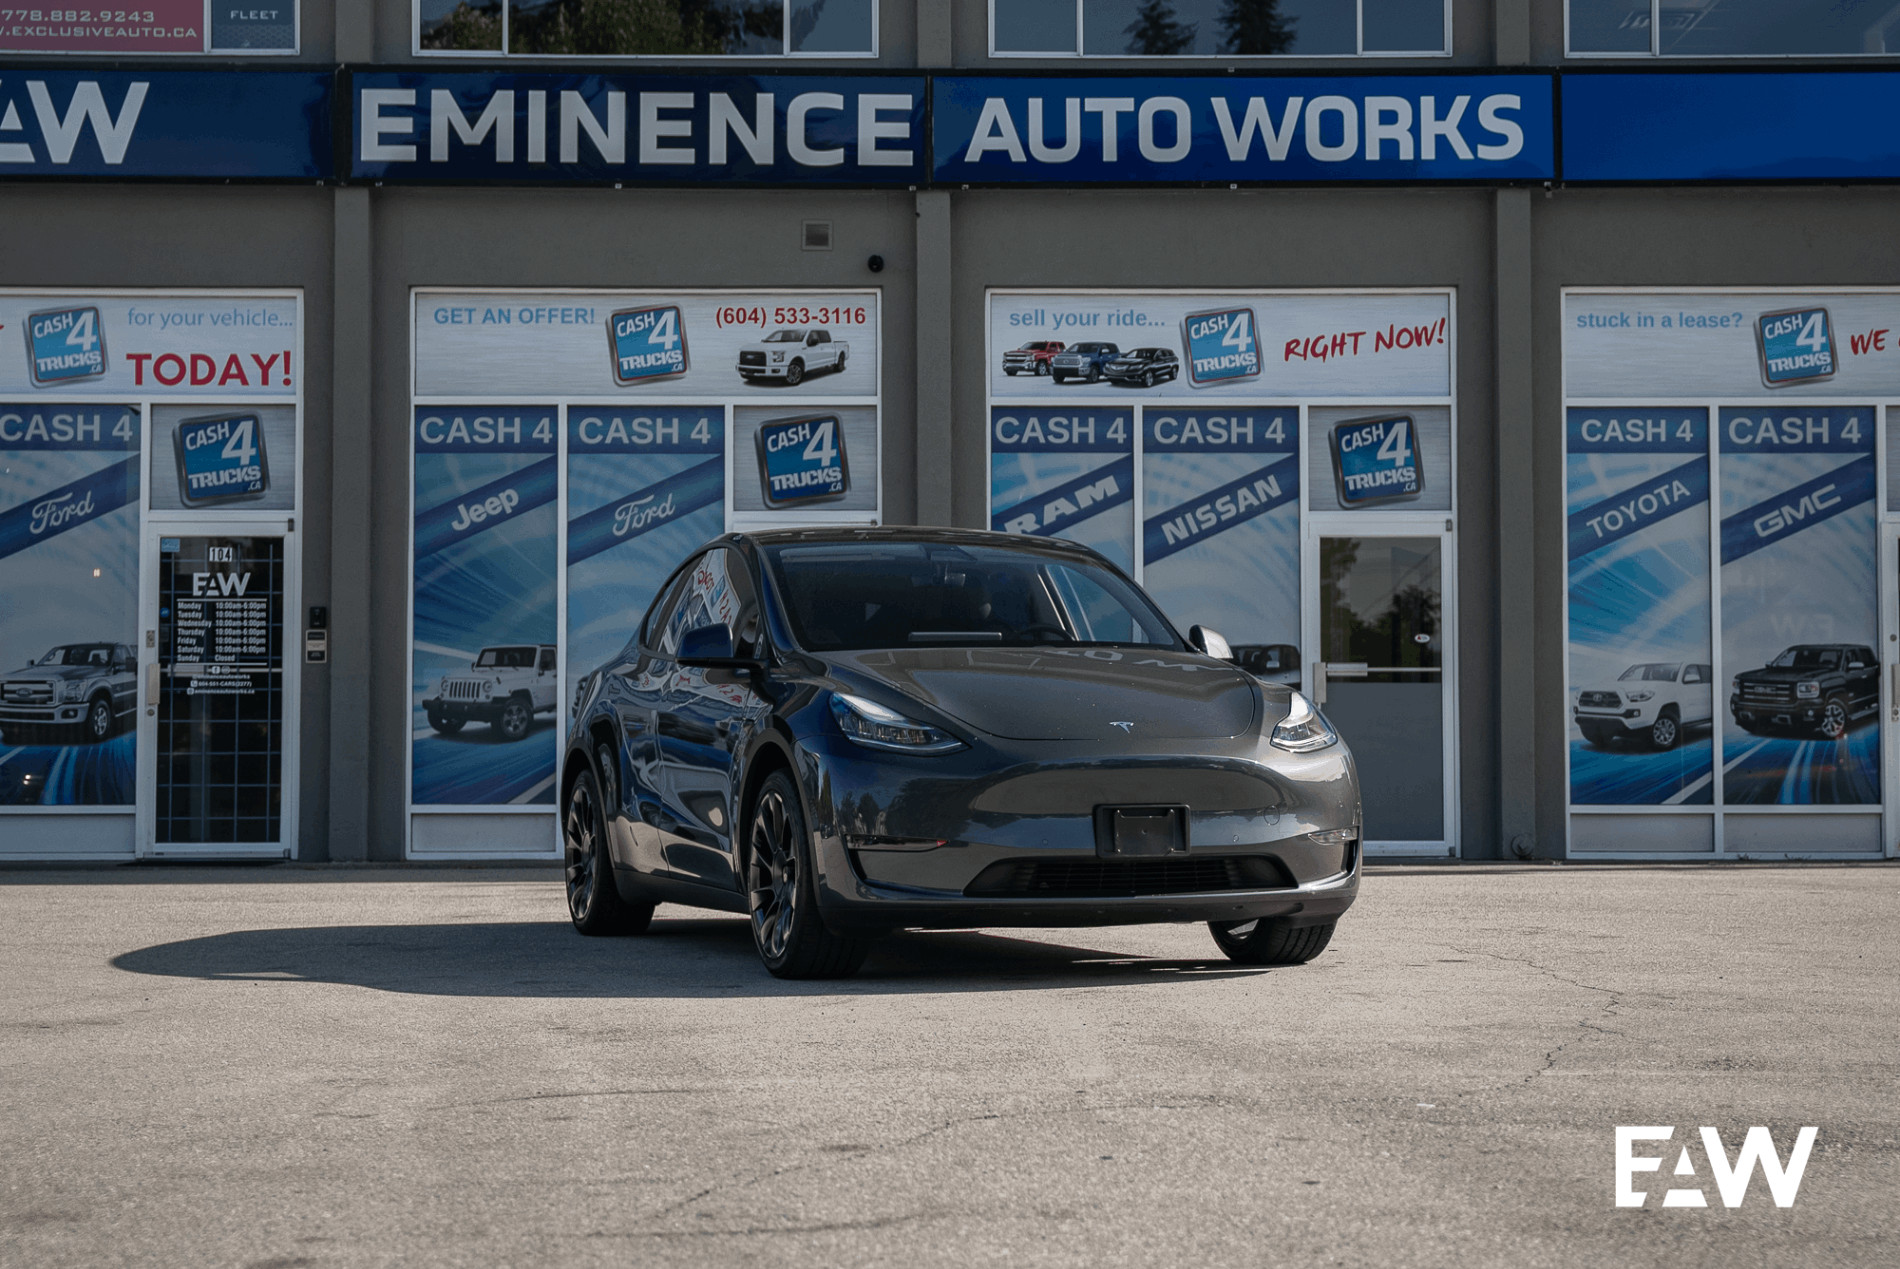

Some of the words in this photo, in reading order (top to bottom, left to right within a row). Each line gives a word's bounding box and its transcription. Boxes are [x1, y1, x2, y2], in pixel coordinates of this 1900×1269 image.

[1, 9, 155, 22] 778.882.9243
[230, 10, 278, 20] FLEET
[0, 80, 150, 164] AW
[360, 88, 913, 167] EMINENCE
[964, 96, 1192, 163] AUTO
[1211, 94, 1524, 161] WORKS
[128, 307, 154, 326] for
[160, 311, 204, 330] your
[210, 308, 293, 326] vehicle...
[434, 308, 476, 324] GET
[481, 308, 512, 324] AN
[518, 308, 594, 324] OFFER!
[616, 312, 655, 338] CASH
[648, 310, 678, 350] 4
[716, 306, 768, 329] (604)
[774, 307, 866, 324] 533-3116
[1009, 309, 1044, 326] sell
[1052, 312, 1100, 331] your
[1106, 309, 1165, 326] ride...
[1576, 312, 1630, 328] stuck
[1637, 312, 1654, 328] in
[1662, 316, 1672, 328] a
[1679, 312, 1743, 328] lease?
[34, 312, 73, 338] CASH
[66, 312, 97, 350] 4
[1190, 313, 1229, 339] CASH
[1221, 312, 1252, 352] 4
[1284, 331, 1366, 362] RIGHT
[1374, 317, 1446, 354] NOW!
[1764, 316, 1802, 339] CASH
[1796, 313, 1826, 352] 4
[1850, 328, 1890, 356] WE
[36, 350, 101, 373] TRUCKS
[126, 351, 292, 386] TODAY!
[620, 350, 682, 372] TRUCKS
[1193, 352, 1256, 373] TRUCKS
[1768, 352, 1832, 372] TRUCKS
[0, 414, 100, 442] CASH
[112, 414, 133, 442] 4
[420, 416, 521, 444] CASH
[532, 416, 552, 444] 4
[578, 416, 678, 444] CASH
[690, 416, 711, 444] 4
[995, 416, 1095, 444] CASH
[1106, 416, 1127, 444] 4
[1154, 416, 1254, 444] CASH
[1264, 416, 1285, 444] 4
[1581, 419, 1666, 442] CASH
[1676, 420, 1693, 442] 4
[1728, 417, 1829, 444] CASH
[1840, 418, 1862, 444] 4
[186, 422, 230, 450] CASH
[221, 420, 256, 466] 4
[766, 423, 810, 452] CASH
[802, 422, 837, 466] 4
[1340, 423, 1384, 452] CASH
[1376, 422, 1412, 466] 4
[188, 466, 262, 489] TRUCKS
[770, 466, 842, 490] TRUCKS
[1344, 466, 1416, 491] TRUCKS
[30, 490, 94, 534] Ford
[451, 486, 519, 532] Jeep
[612, 494, 676, 536] Ford
[1004, 475, 1120, 534] RAM
[1160, 474, 1282, 545] NISSAN
[1586, 480, 1691, 538] TOYOTA
[1753, 484, 1842, 538] GMC
[211, 549, 231, 561] 104
[214, 654, 235, 662] Closed
